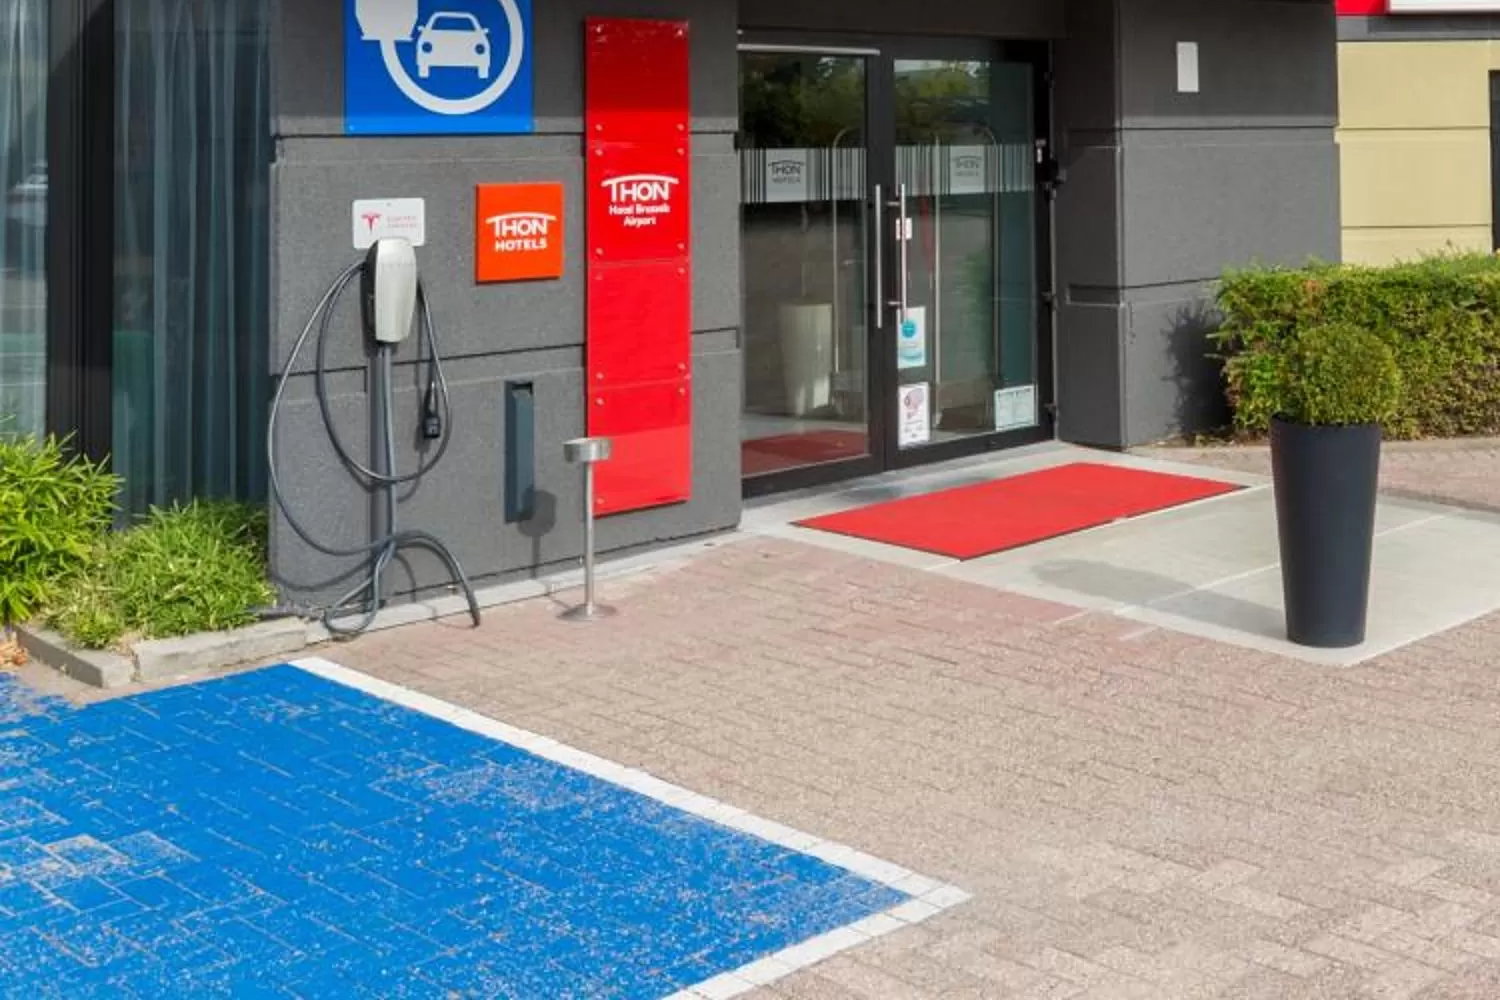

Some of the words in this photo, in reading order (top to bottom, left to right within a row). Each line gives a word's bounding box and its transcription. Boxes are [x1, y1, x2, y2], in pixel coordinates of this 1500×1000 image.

[601, 174, 679, 202] THON
[485, 212, 557, 237] THON
[495, 237, 547, 252] HOTELS
